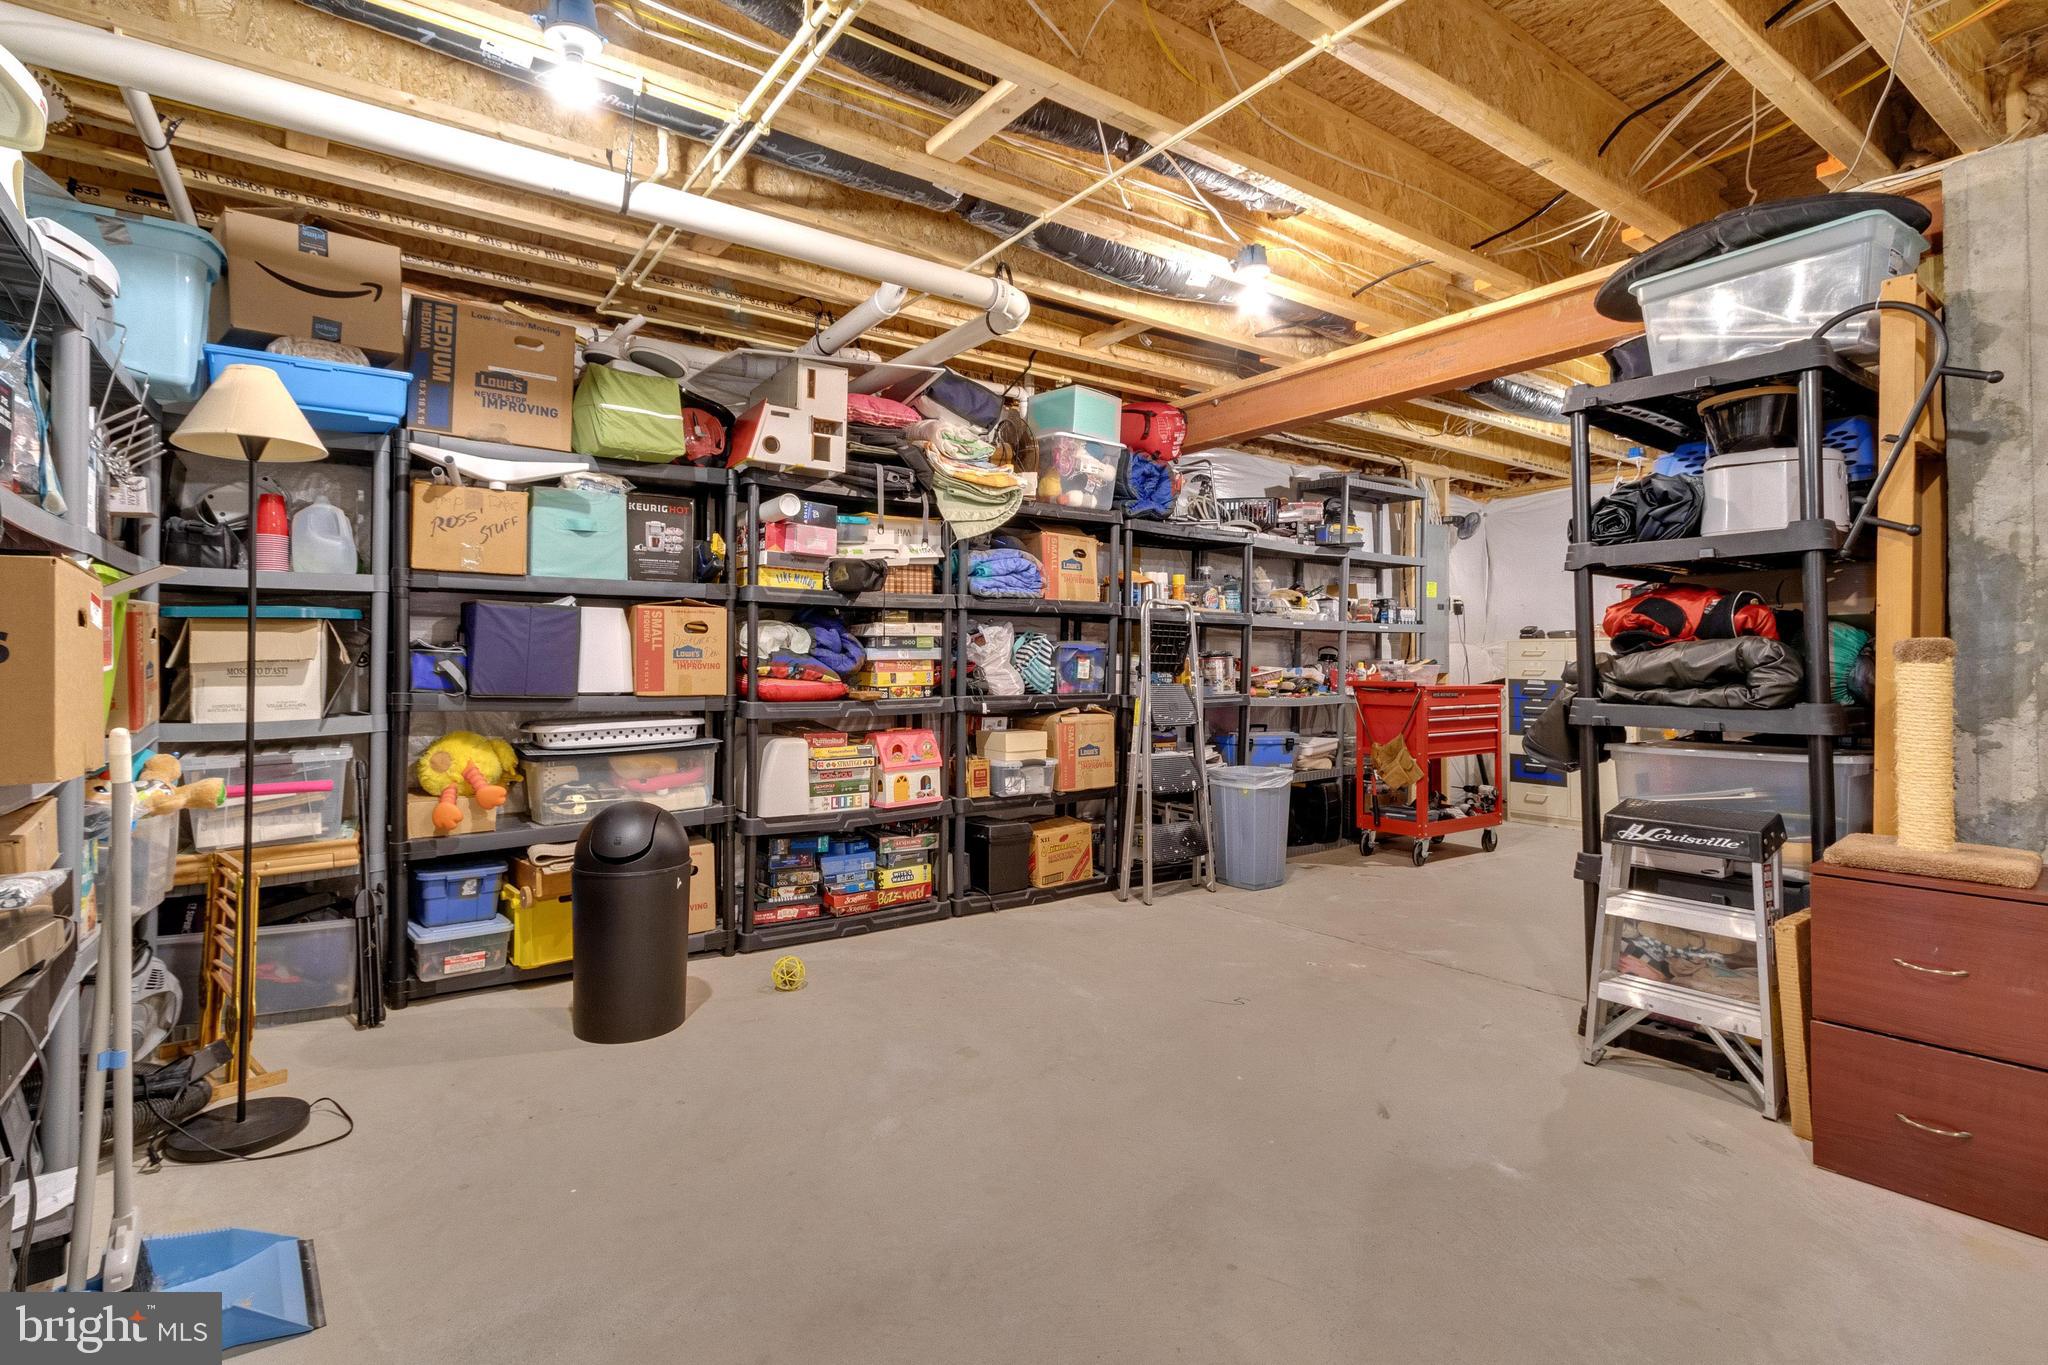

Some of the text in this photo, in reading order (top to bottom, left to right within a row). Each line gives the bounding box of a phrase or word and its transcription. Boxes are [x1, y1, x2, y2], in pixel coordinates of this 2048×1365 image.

[192, 168, 208, 181] IN
[217, 175, 267, 195] CANADA
[274, 187, 299, 202] APA
[420, 302, 432, 349] MEDIANA
[432, 304, 454, 382] MEDIUM
[480, 374, 524, 392] LOWE'S
[474, 390, 527, 404] NEVER STOP
[482, 397, 559, 418] IMPROVING
[628, 502, 689, 515] KEURIG HOT
[480, 516, 519, 544] STUFF
[776, 571, 791, 583] LIKE
[651, 610, 663, 652] SMALL
[227, 666, 289, 676] MOSCO D'ASTI
[677, 661, 721, 670] IMPROVING
[832, 796, 861, 809] LIFE
[1629, 826, 1741, 849] Louisville
